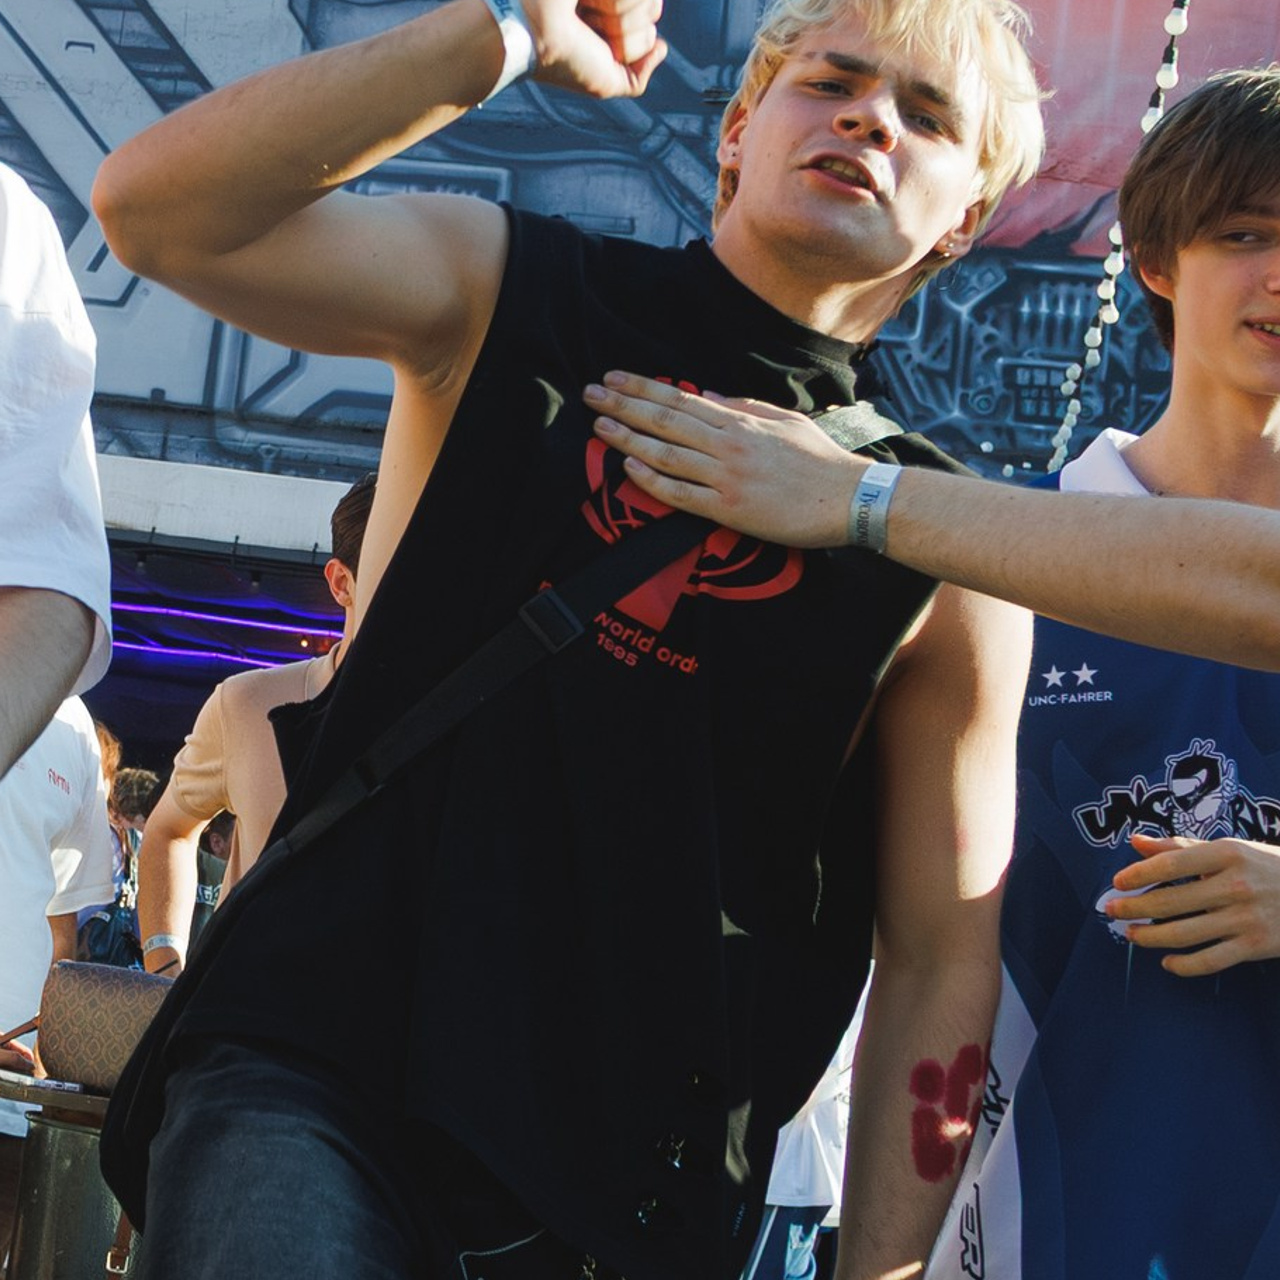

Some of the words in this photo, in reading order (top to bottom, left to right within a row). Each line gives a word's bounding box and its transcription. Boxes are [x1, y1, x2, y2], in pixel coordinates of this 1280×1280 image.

[596, 632, 638, 667] 1995
[656, 645, 699, 675] ord
[1028, 690, 1114, 708] UNC-FAHRER
